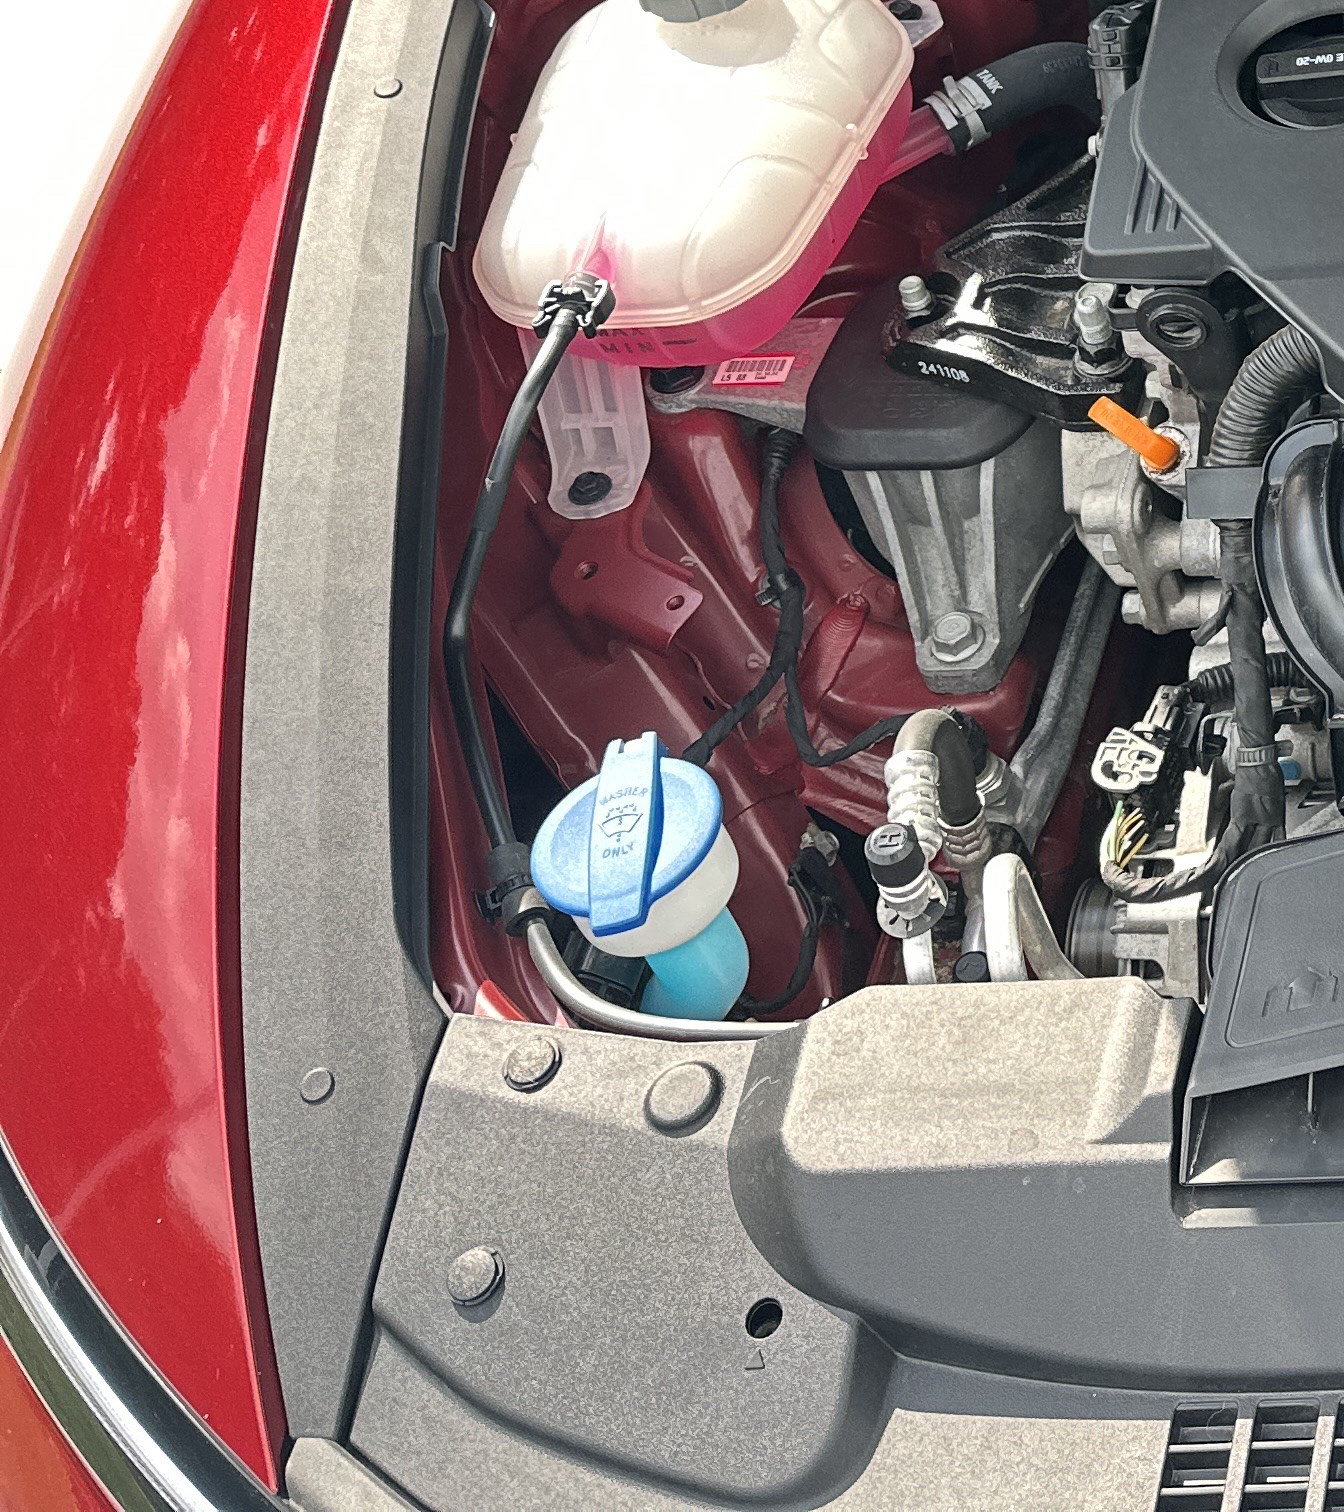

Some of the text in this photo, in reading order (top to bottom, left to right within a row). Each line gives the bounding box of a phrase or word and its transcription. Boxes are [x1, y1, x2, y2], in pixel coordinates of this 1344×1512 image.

[1295, 52, 1334, 67] 0W-20
[976, 68, 1003, 94] TANK
[918, 360, 970, 384] 241108
[599, 786, 649, 806] WASHER
[602, 841, 634, 859] ONLY
